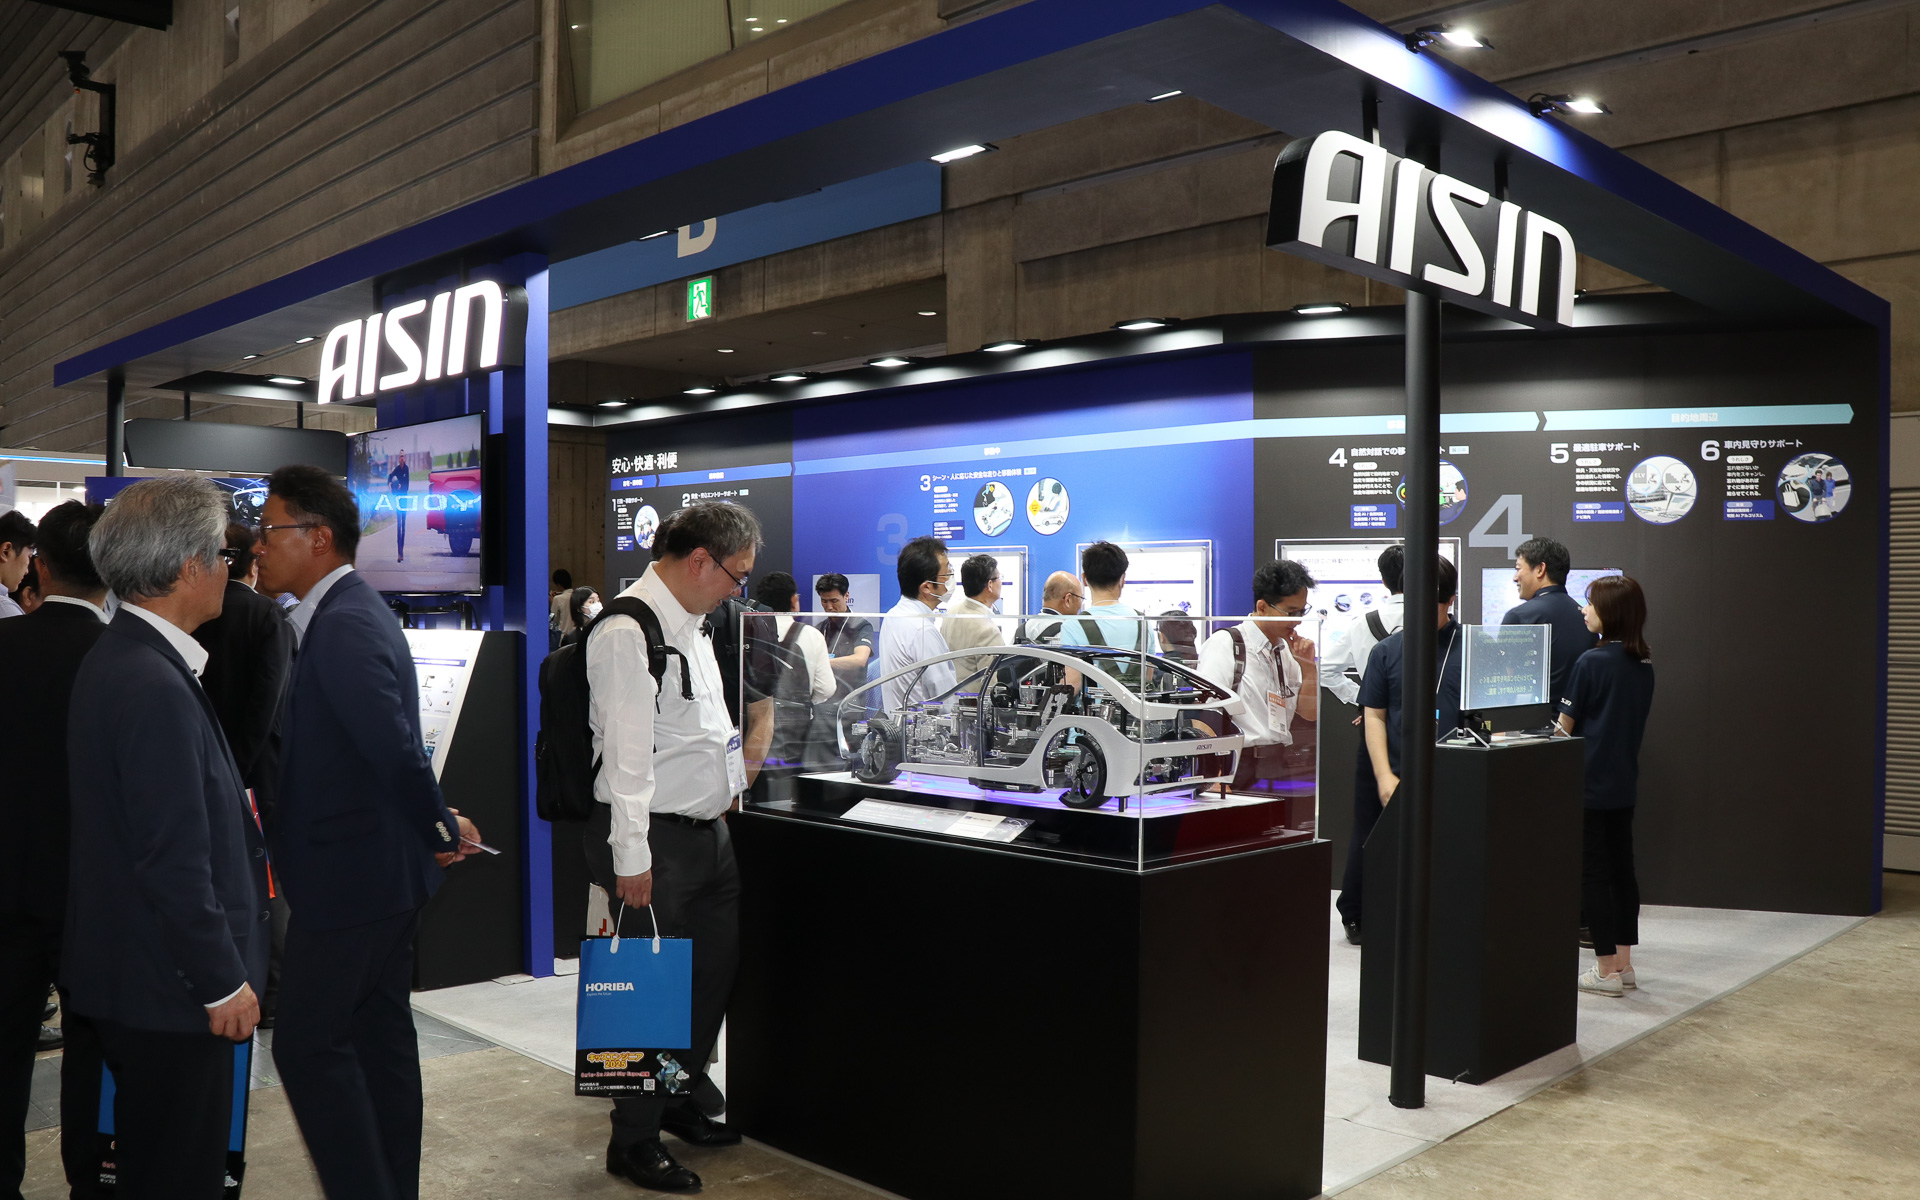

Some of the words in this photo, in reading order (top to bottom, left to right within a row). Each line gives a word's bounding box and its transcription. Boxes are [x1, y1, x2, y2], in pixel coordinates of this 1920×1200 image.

[1298, 130, 1577, 328] AISIN
[318, 280, 503, 405] AISIN
[1550, 443, 1569, 464] 5
[1701, 440, 1720, 461] 6
[1724, 439, 1803, 449] 車内見守りサポート
[612, 452, 678, 474] 安心・快適・利便
[1328, 448, 1348, 467] 4
[920, 475, 931, 491] 3
[682, 493, 690, 507] 2
[1469, 494, 1533, 559] 4
[585, 982, 634, 992] HORIBA
[587, 1052, 644, 1063] キッズエンジニア
[604, 1060, 627, 1068] 2025
